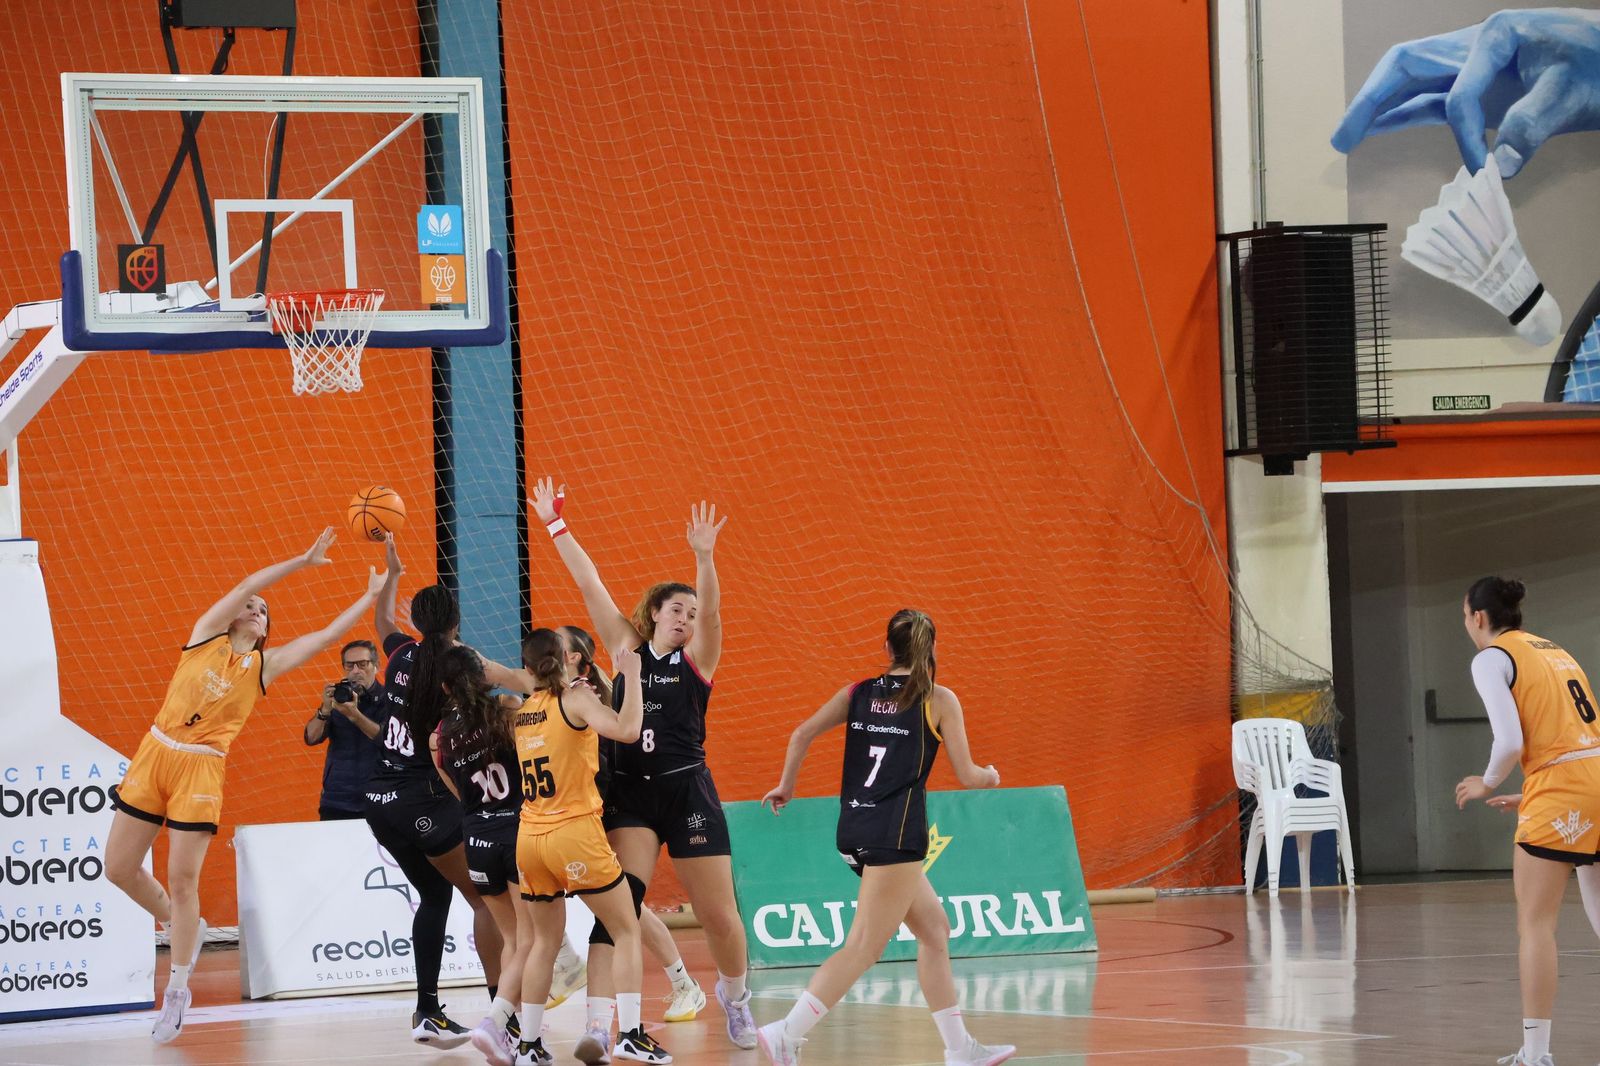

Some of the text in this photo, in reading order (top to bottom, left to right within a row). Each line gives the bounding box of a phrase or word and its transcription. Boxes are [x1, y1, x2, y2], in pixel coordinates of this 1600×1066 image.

[20, 351, 43, 382] Sports
[1567, 679, 1597, 724] 8
[642, 729, 656, 752] 8
[867, 724, 910, 736] GardenStore
[470, 762, 510, 803] 10
[522, 756, 556, 803] 55
[864, 745, 887, 788] 7
[753, 901, 858, 948] CAJ
[312, 930, 456, 962] recoles
[0, 972, 88, 993] obreros
